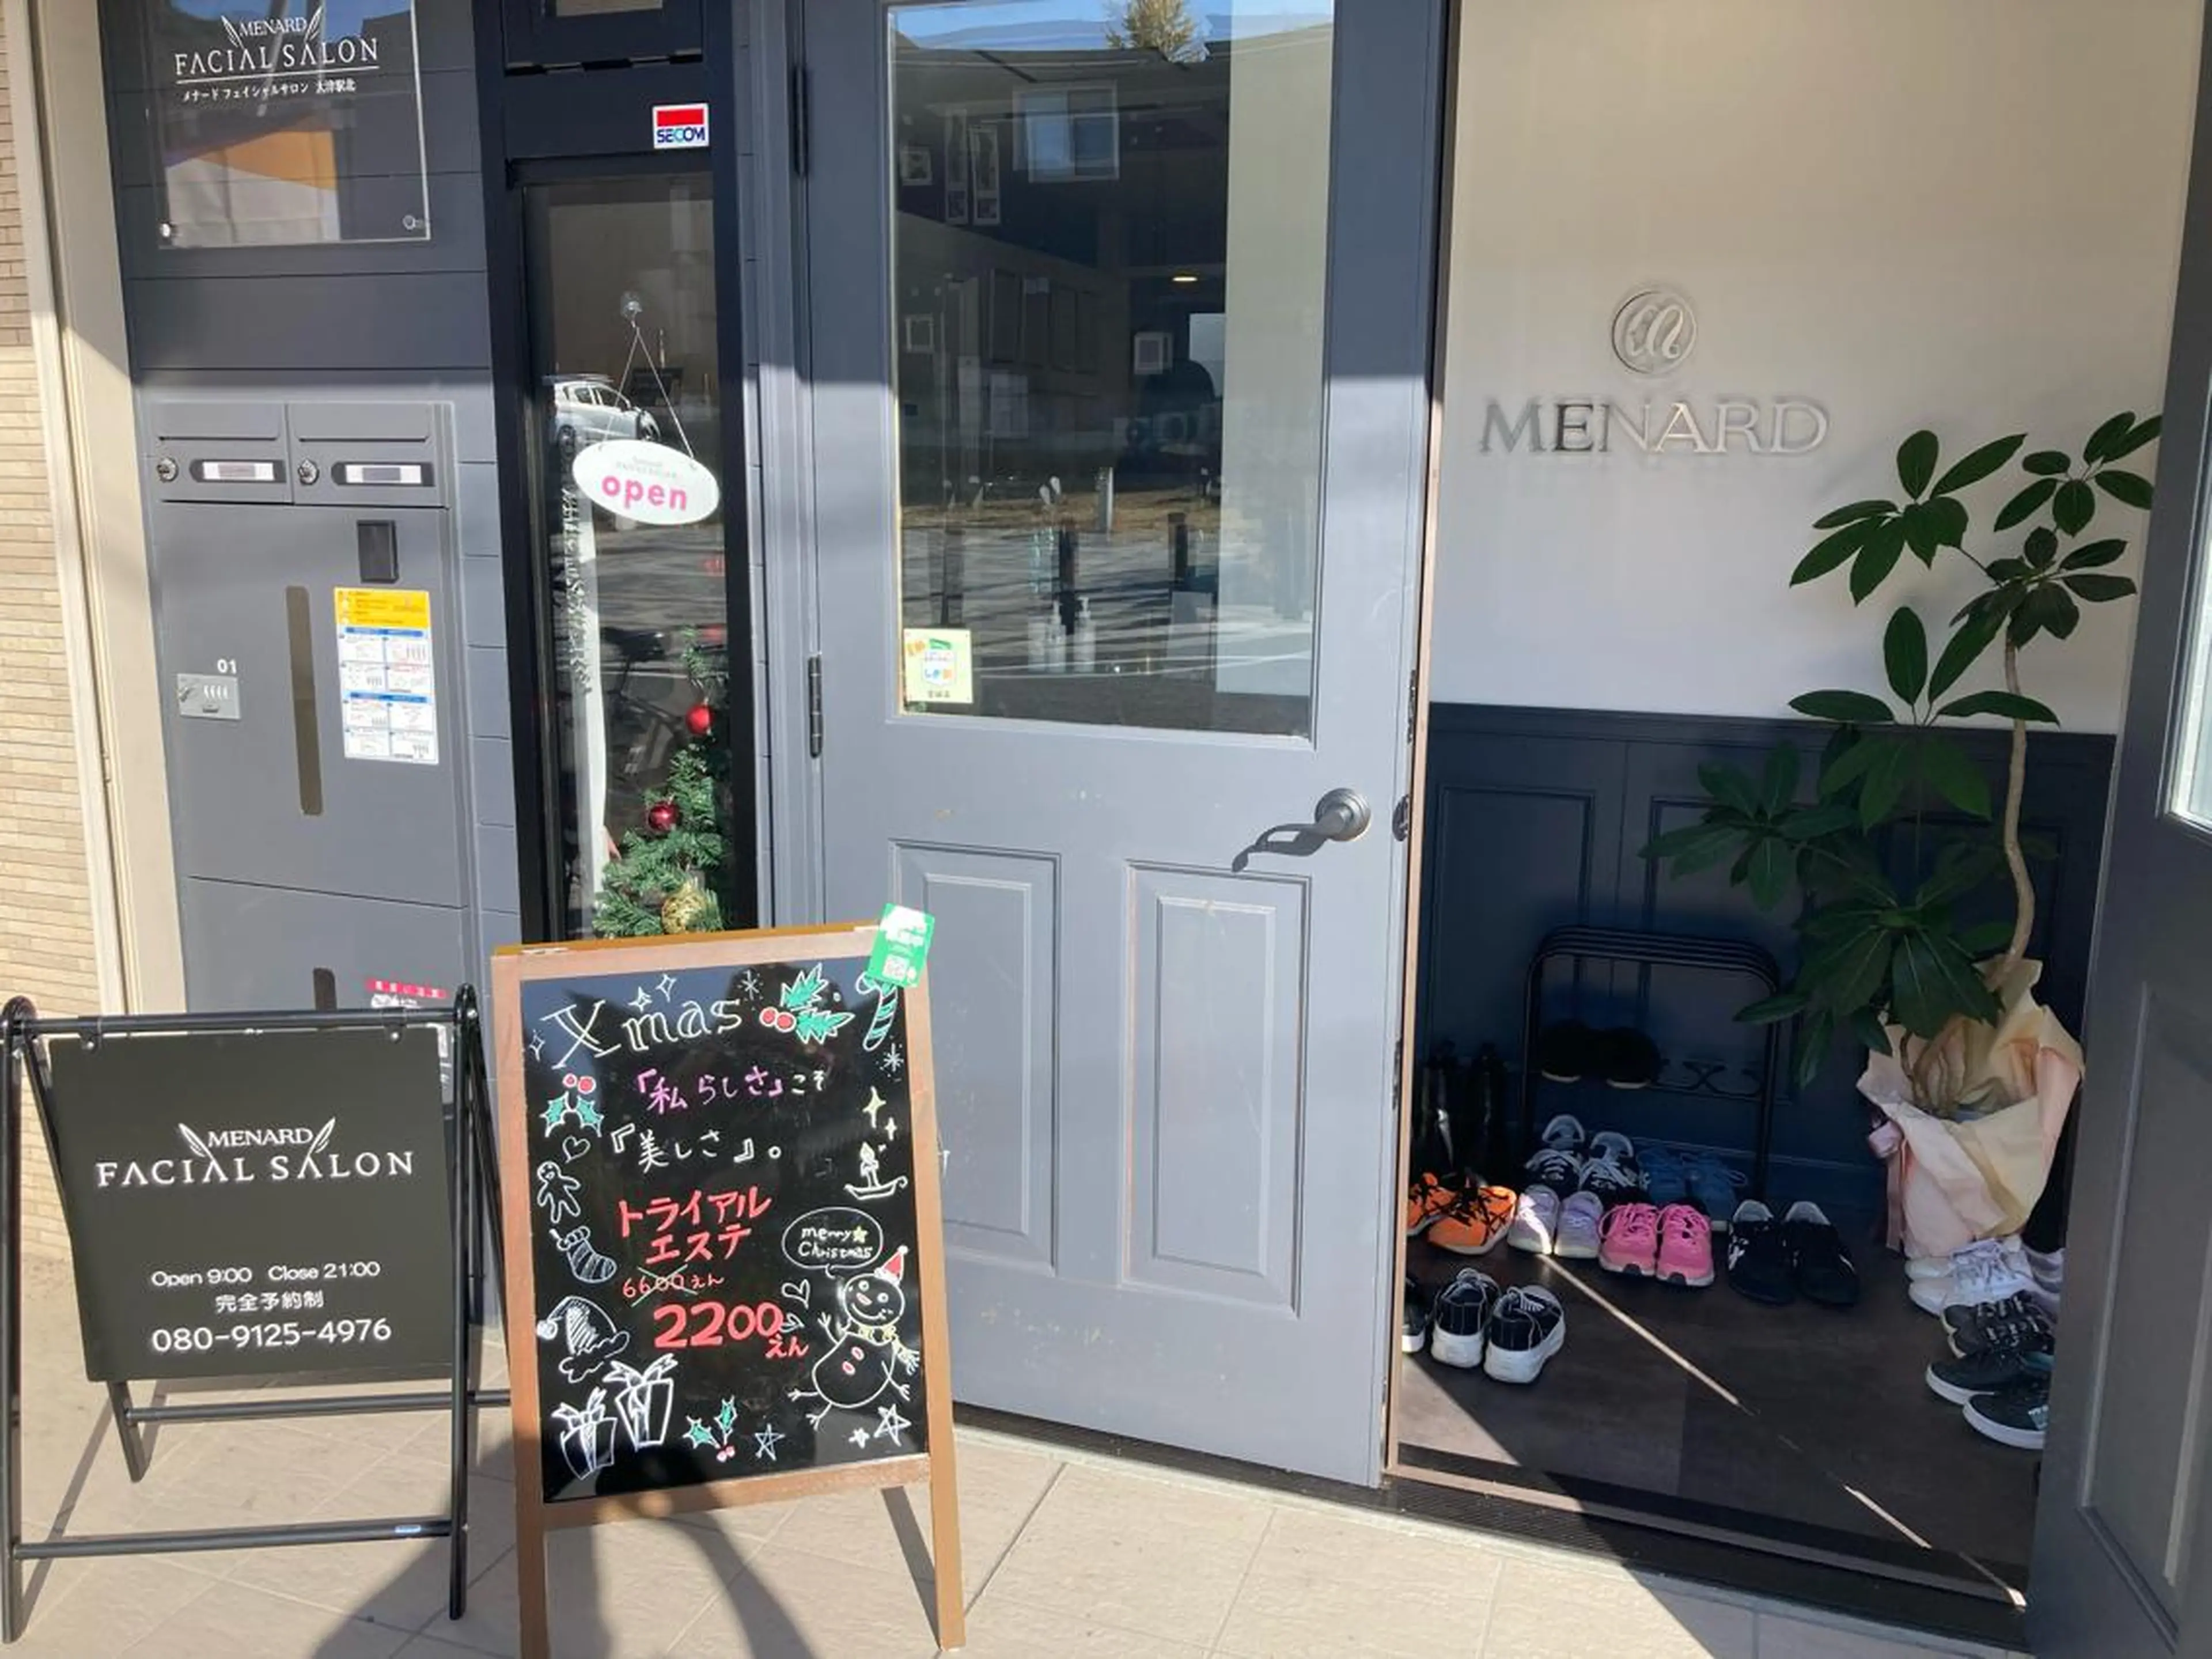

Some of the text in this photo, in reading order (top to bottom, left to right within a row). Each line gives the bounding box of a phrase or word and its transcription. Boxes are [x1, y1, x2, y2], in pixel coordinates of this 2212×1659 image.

[239, 17, 308, 37] MENARD
[175, 38, 378, 75] FACIAL SALON
[657, 126, 706, 143] SECOM
[1479, 396, 1831, 455] MENARD
[601, 475, 687, 512] open
[217, 658, 237, 675] 01
[207, 1127, 313, 1148] MENARD
[96, 1152, 414, 1187] FACIAL SALON
[619, 1185, 772, 1238] トライアル
[645, 1222, 752, 1265] エステ
[151, 1261, 381, 1287] Open 9:00 Close 21:00
[215, 1290, 324, 1313] 完全予約制
[151, 1317, 392, 1353] 080-9125-4976
